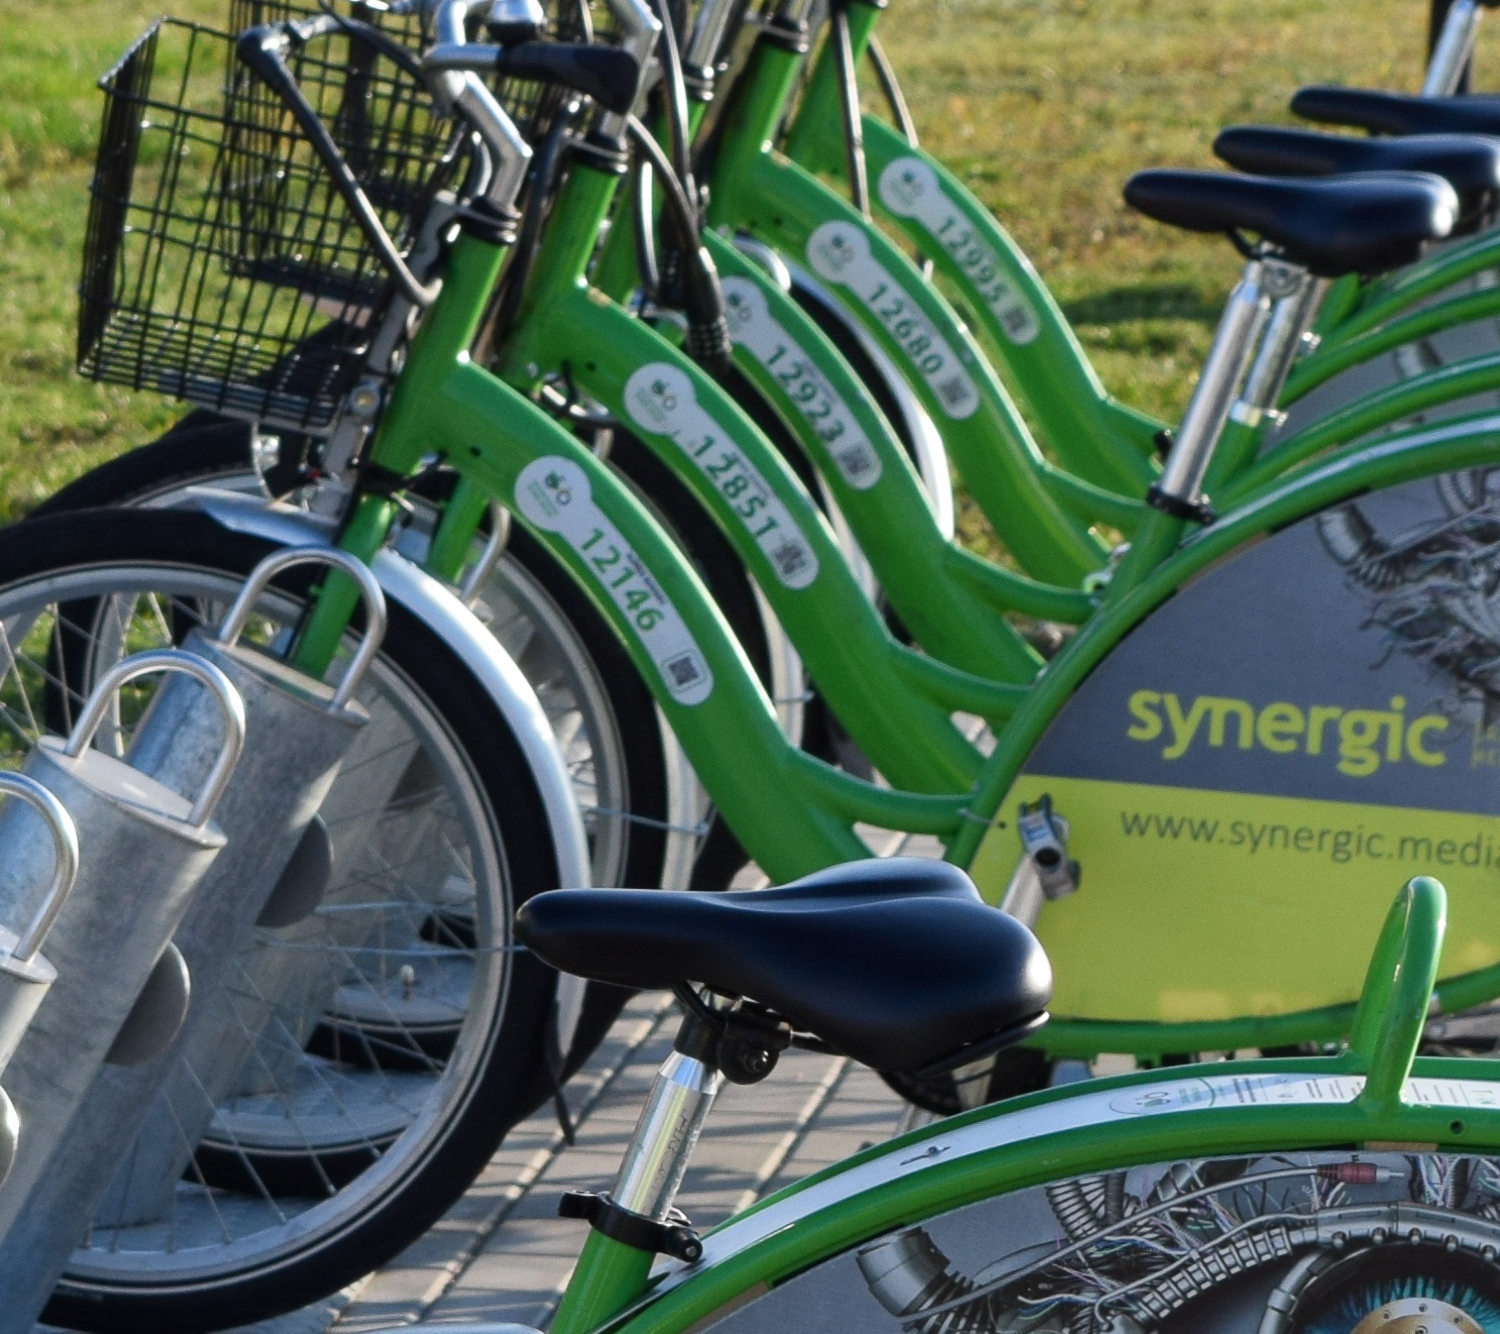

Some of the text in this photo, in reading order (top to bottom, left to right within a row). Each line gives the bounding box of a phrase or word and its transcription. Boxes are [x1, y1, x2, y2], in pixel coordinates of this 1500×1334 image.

[869, 282, 944, 375] 12680
[767, 345, 846, 443] 12923
[694, 435, 779, 538] 12851
[581, 527, 665, 632] 12146
[1126, 688, 1450, 778] synergic
